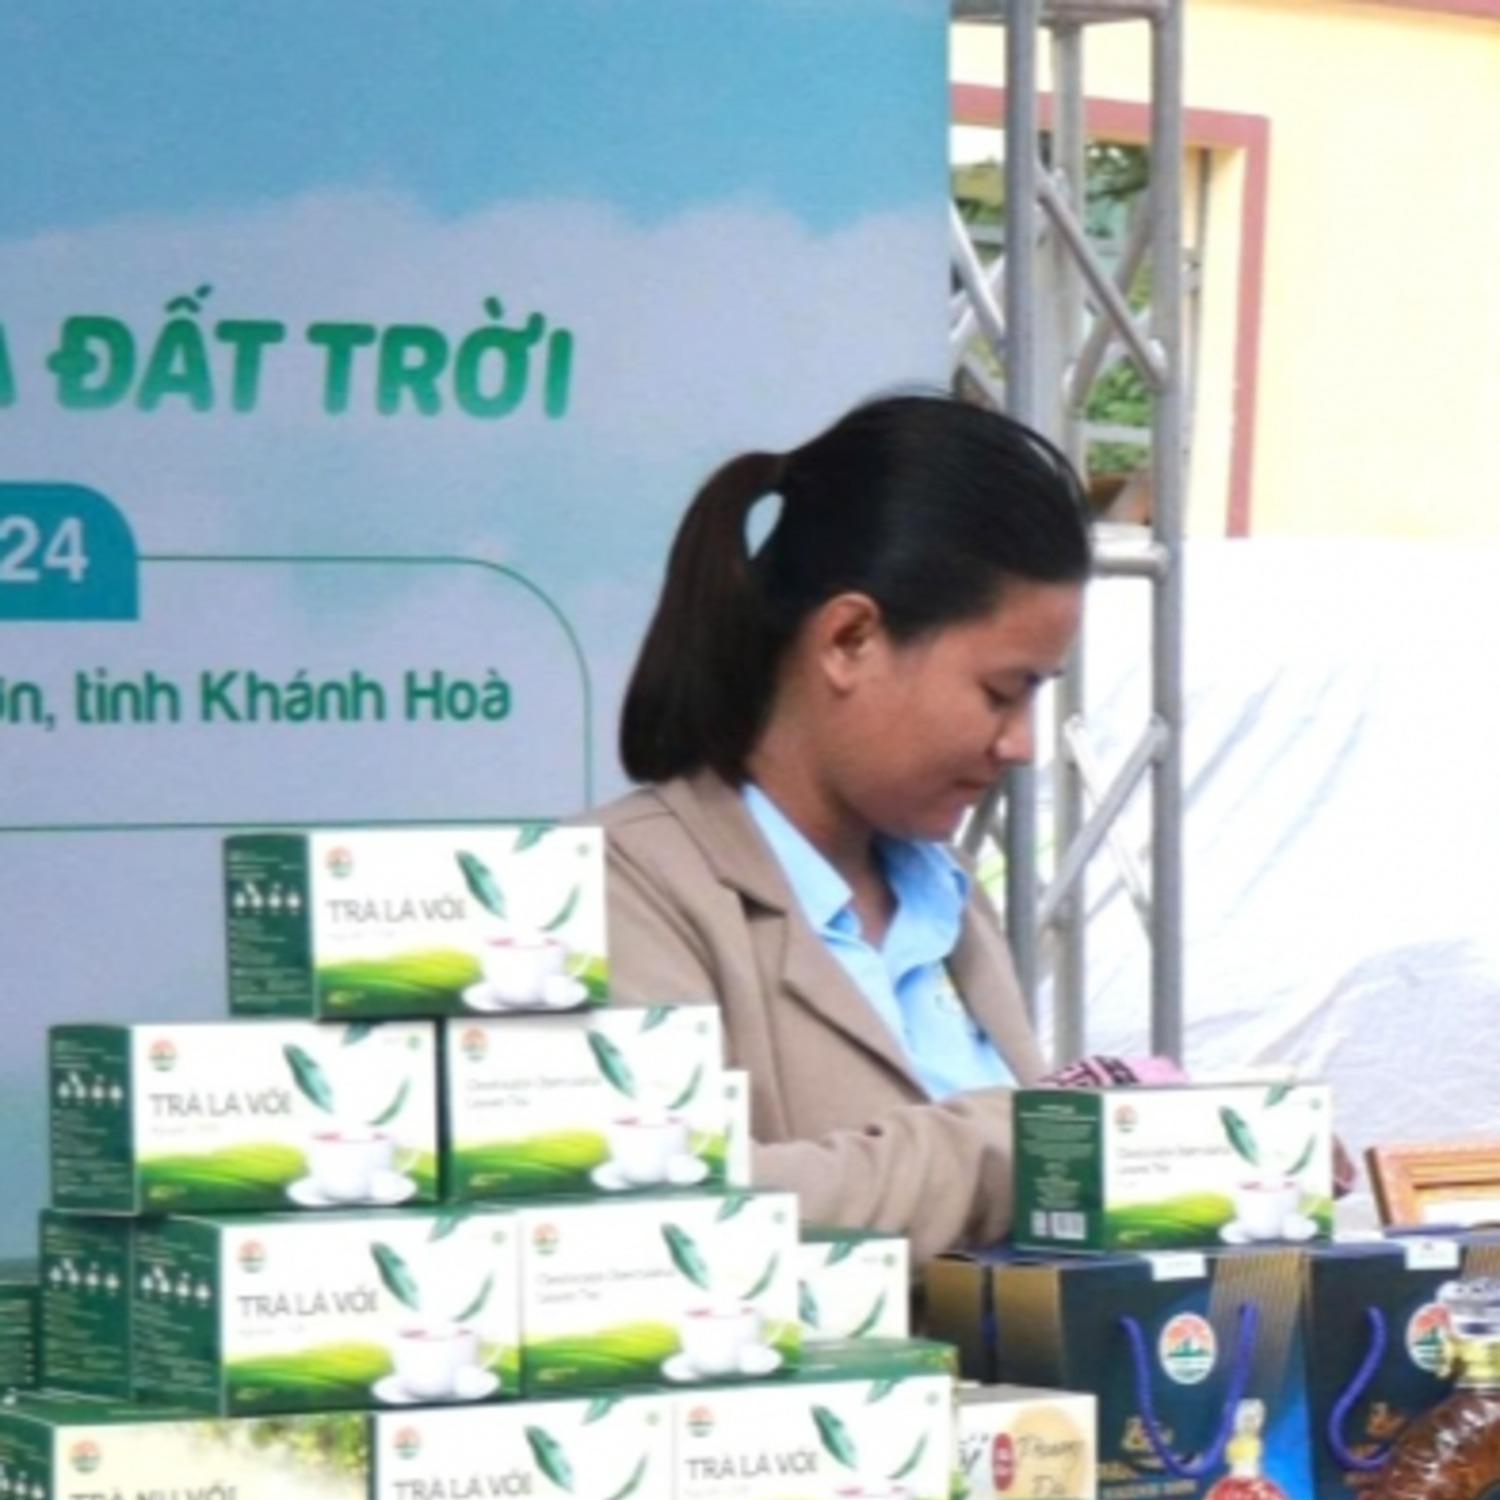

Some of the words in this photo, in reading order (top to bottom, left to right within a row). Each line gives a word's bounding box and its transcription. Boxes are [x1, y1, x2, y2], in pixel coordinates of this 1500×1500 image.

[46, 284, 286, 412] ĐẤT
[306, 296, 574, 420] TRỜI
[75, 666, 180, 724] tỉnh
[200, 667, 386, 722] Khánh
[403, 667, 511, 722] Hoà
